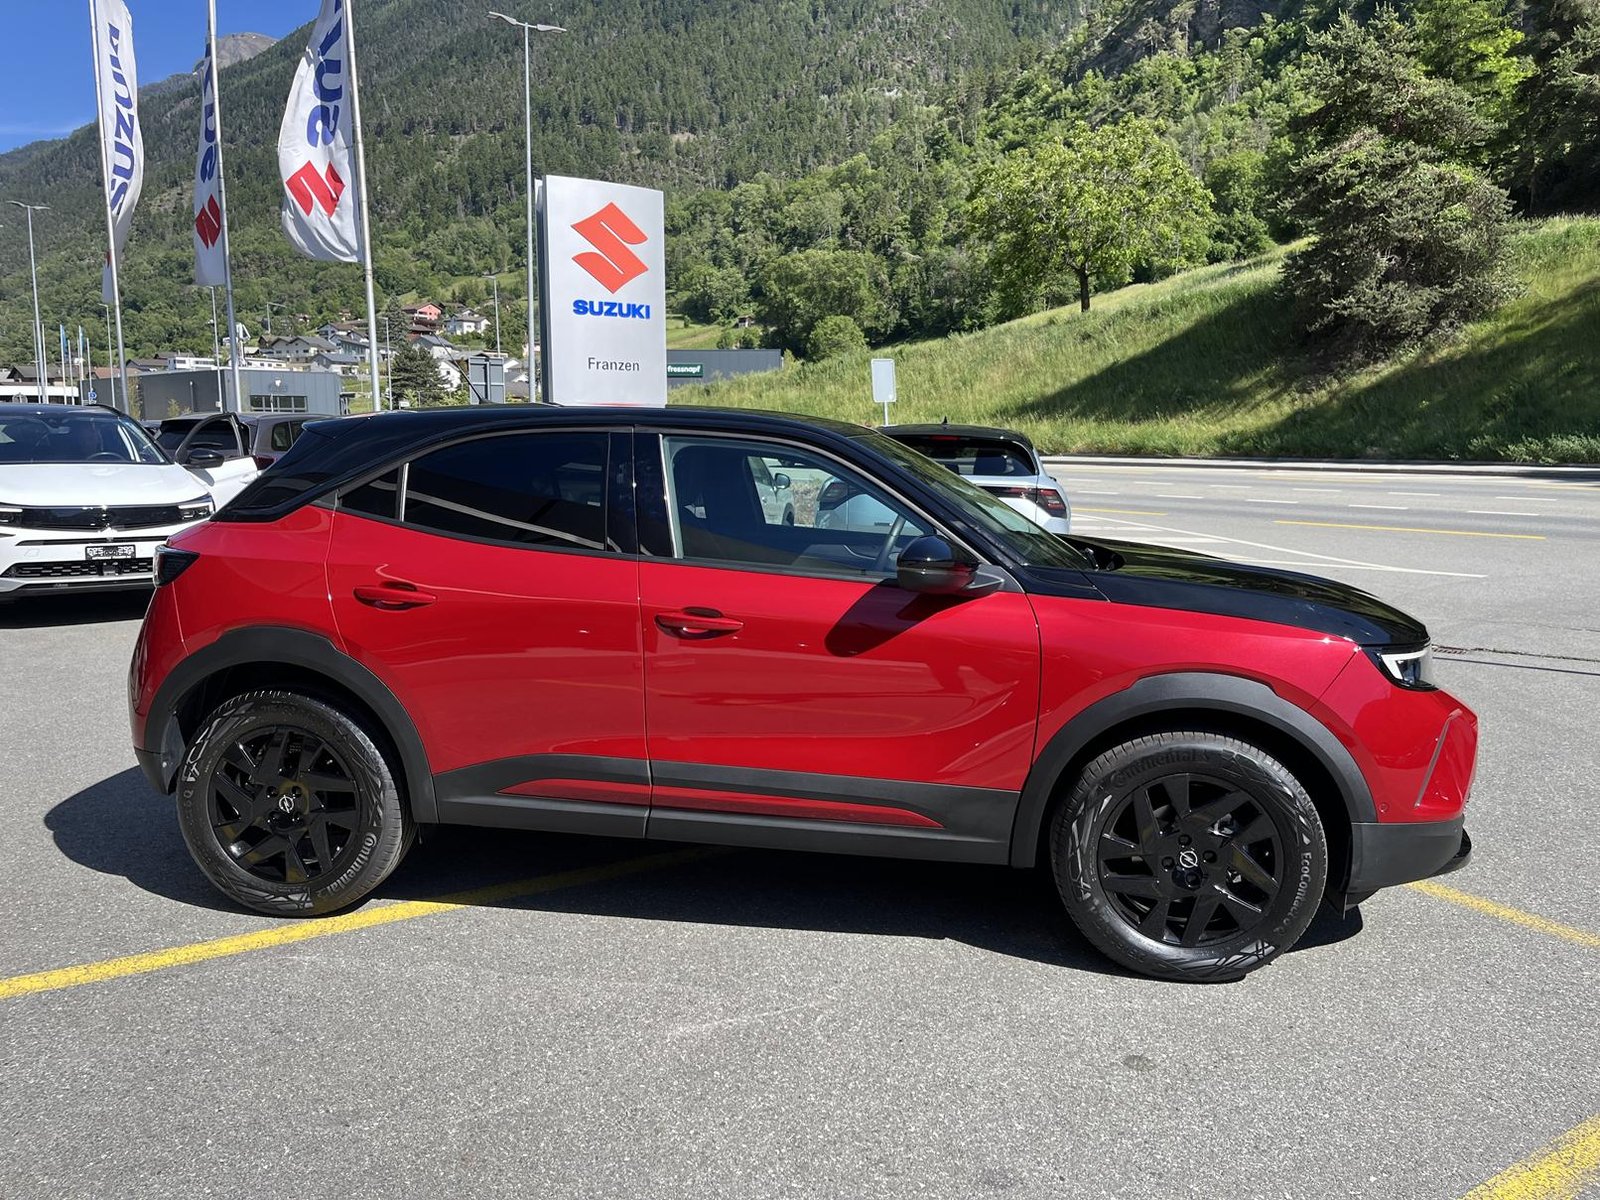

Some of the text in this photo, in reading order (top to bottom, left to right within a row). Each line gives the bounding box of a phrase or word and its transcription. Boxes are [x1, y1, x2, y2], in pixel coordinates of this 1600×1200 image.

[573, 299, 650, 319] SUZUKI
[588, 357, 640, 371] Franzen
[326, 832, 377, 896] Continental
[1287, 852, 1312, 918] EcoContact
